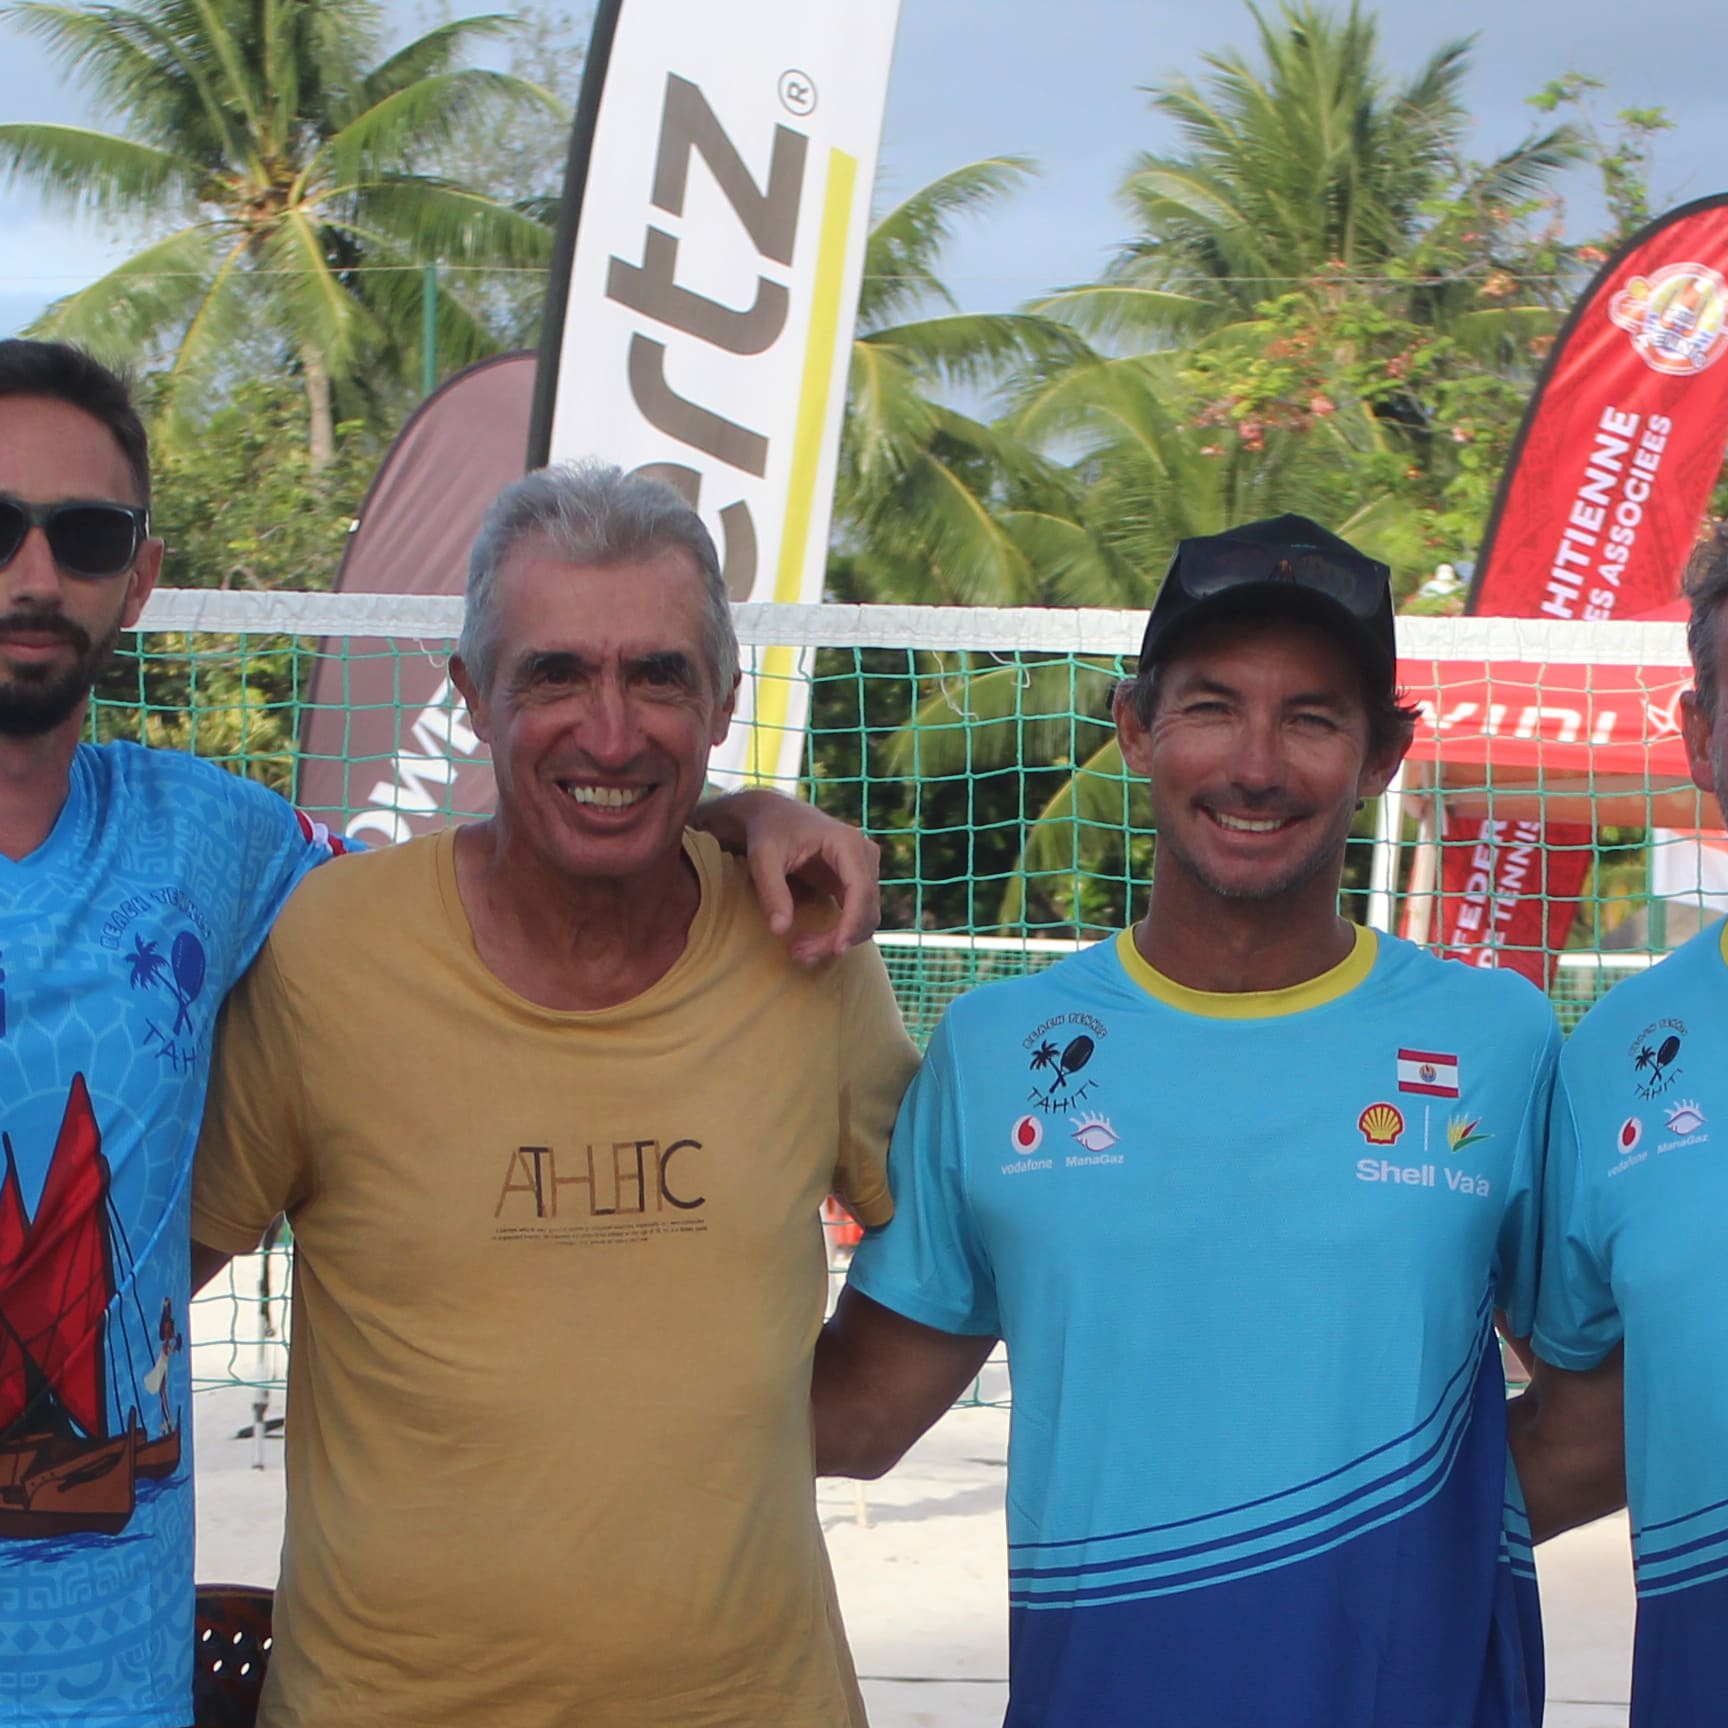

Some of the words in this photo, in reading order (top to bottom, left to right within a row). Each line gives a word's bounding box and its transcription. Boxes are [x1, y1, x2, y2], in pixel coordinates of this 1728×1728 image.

[1542, 405, 1641, 619] HITIENNE
[1598, 413, 1672, 588] ASSOCIEES
[1027, 1079, 1100, 1114] TAHITI
[1001, 1158, 1054, 1176] vodafone
[1356, 1158, 1436, 1188] Shell
